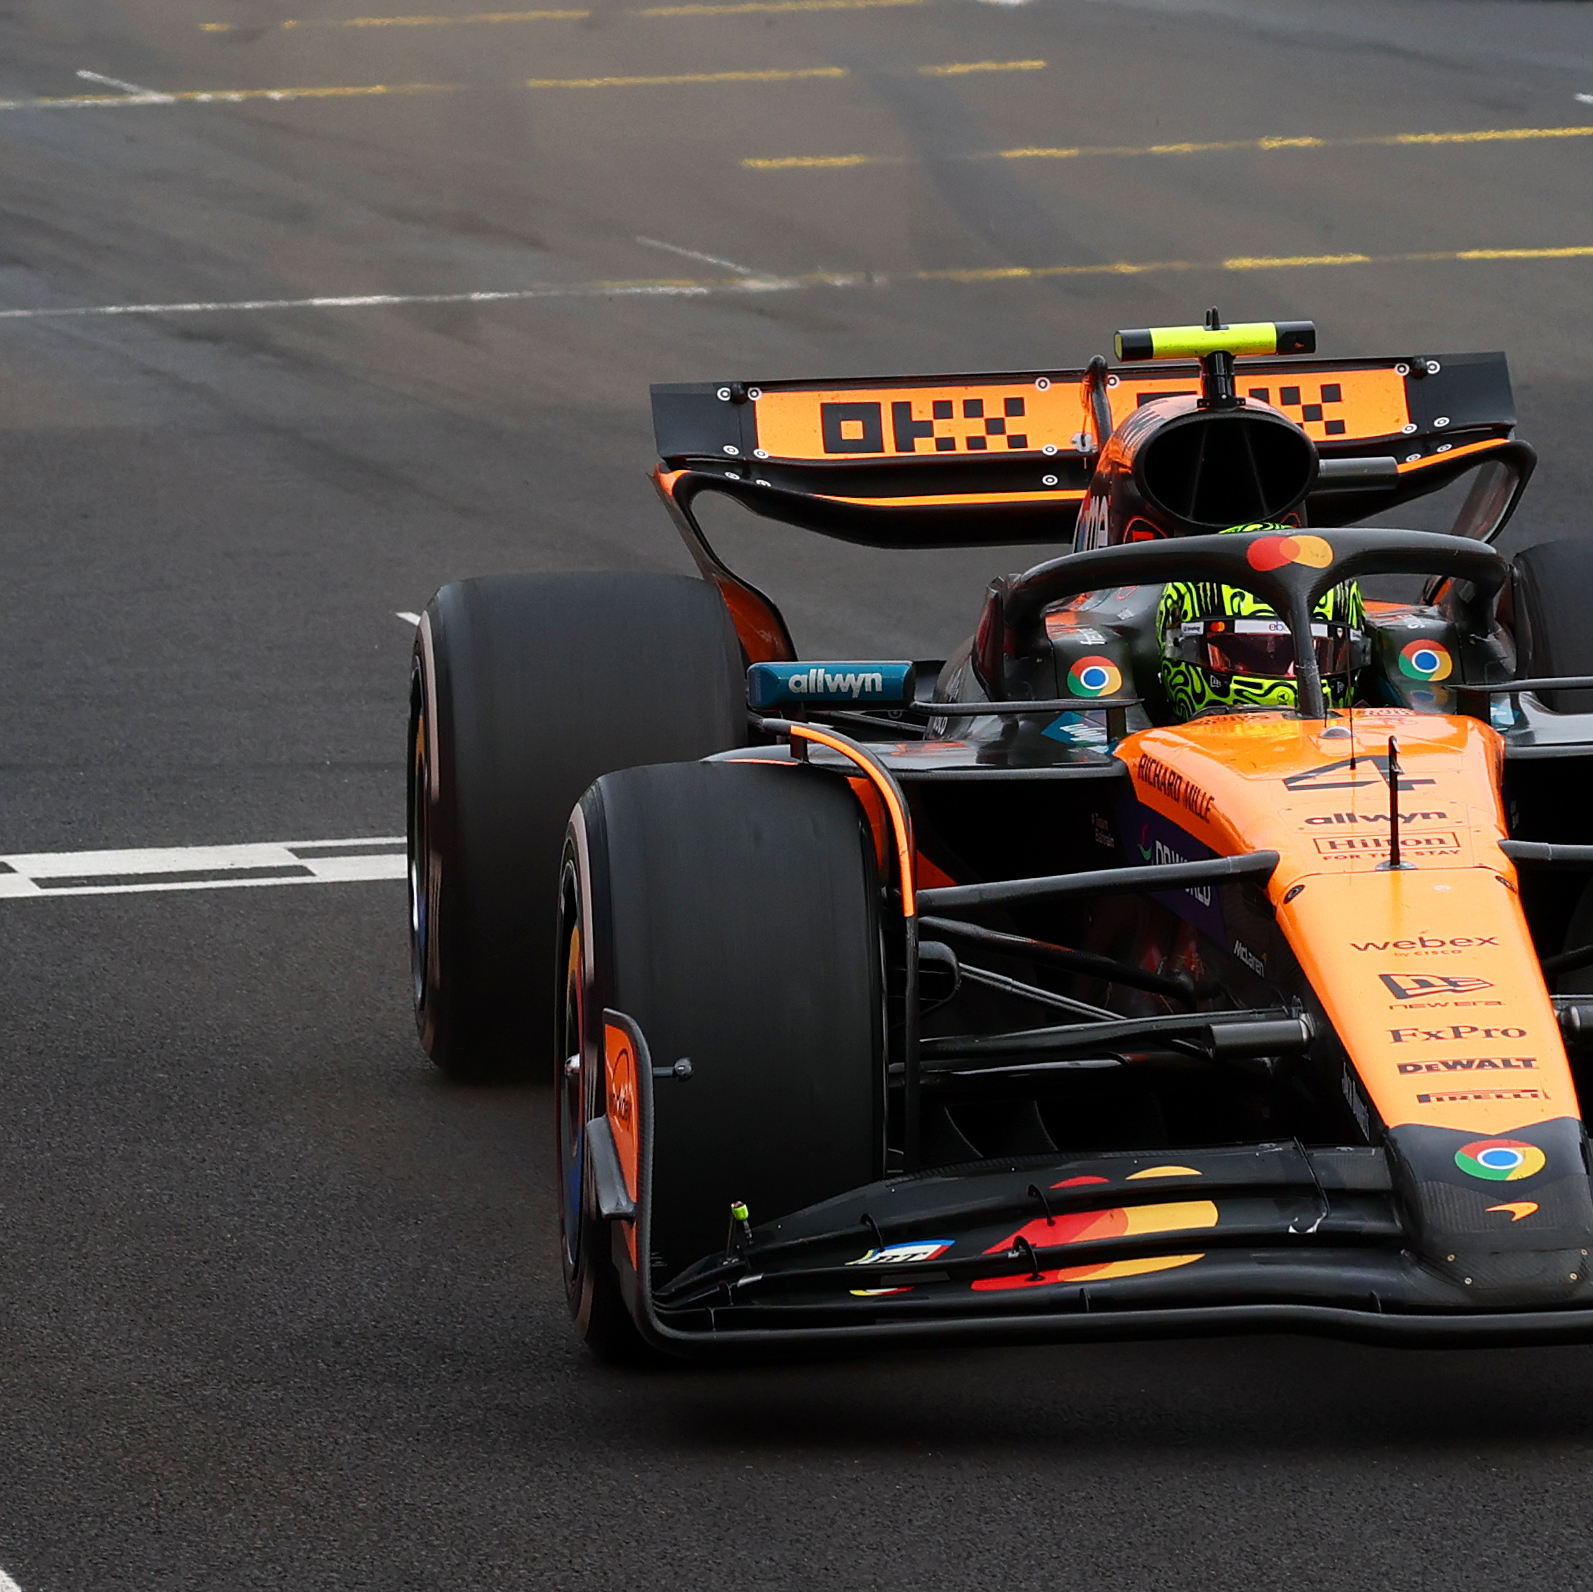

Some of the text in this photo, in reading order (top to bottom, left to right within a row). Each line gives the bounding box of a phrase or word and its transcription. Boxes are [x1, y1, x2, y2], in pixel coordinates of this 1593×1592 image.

[788, 668, 883, 699] allwyn
[1282, 755, 1437, 792] 4
[1137, 753, 1216, 824] RICHARD MILLE
[1304, 810, 1448, 826] allwyn
[1322, 854, 1356, 862] FOR
[1414, 849, 1461, 857] STAY
[1350, 931, 1501, 952] webex
[1233, 939, 1266, 979] McLaren
[1386, 1024, 1528, 1045] FxPro
